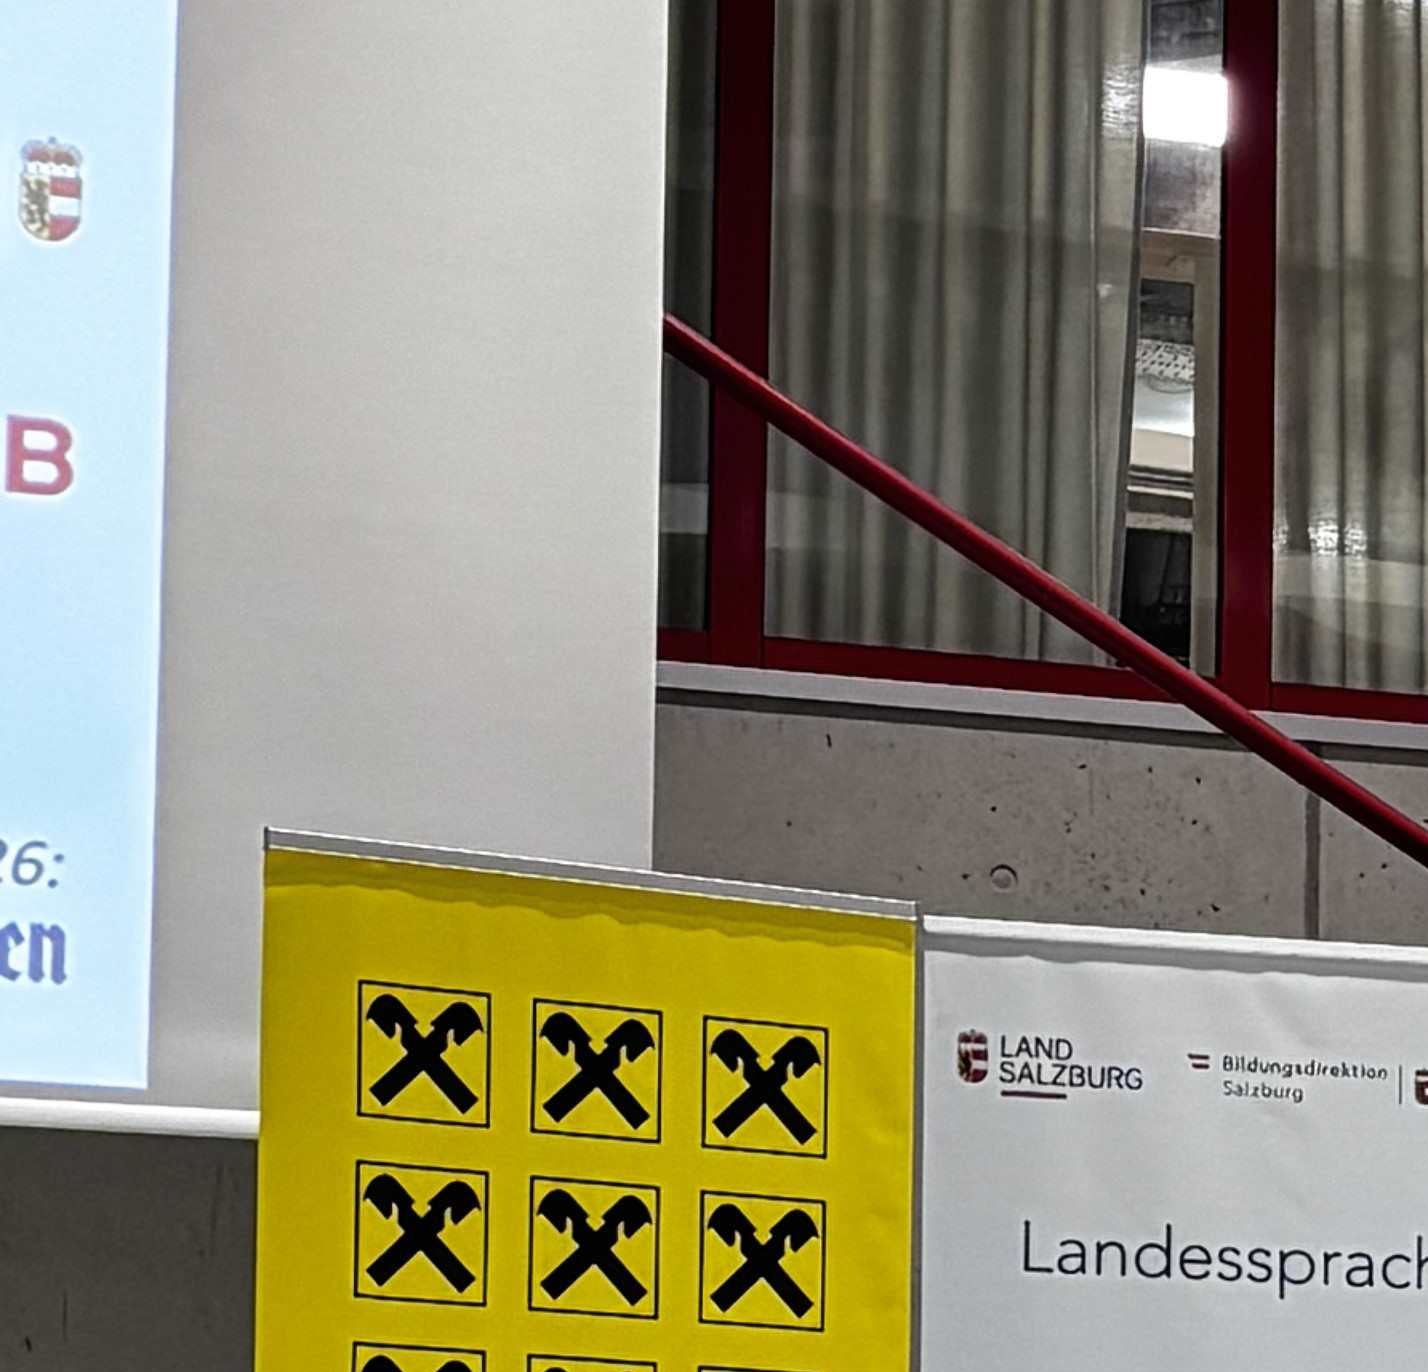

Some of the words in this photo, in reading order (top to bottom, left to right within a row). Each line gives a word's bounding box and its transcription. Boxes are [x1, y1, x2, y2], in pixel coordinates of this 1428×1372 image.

[1001, 1035, 1074, 1061] LAND
[999, 1061, 1144, 1091] SALZBURG
[1222, 1055, 1388, 1080] Bildungsdirektion
[1223, 1080, 1304, 1103] Salzburg
